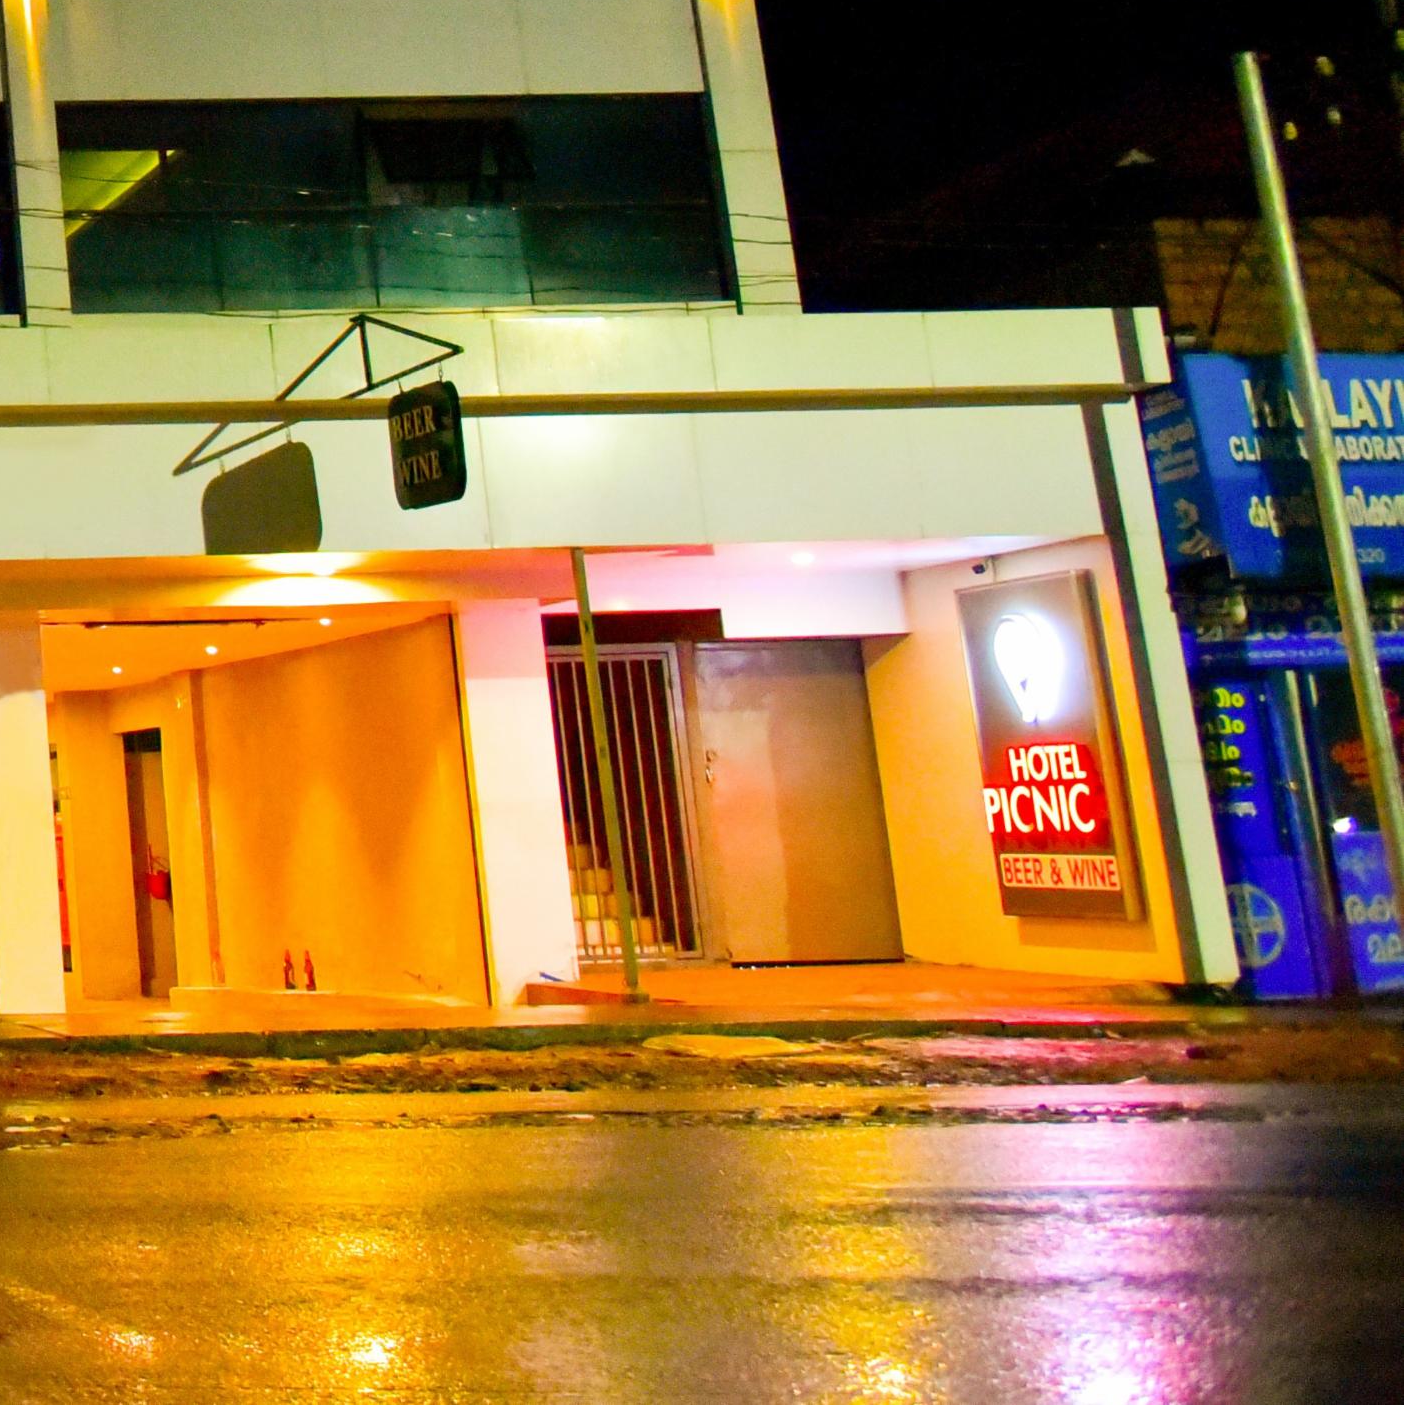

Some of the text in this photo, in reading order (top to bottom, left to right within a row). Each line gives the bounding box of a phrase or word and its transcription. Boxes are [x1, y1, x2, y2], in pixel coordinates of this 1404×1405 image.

[392, 405, 436, 440] BEER
[399, 450, 442, 485] WINE
[1008, 744, 1087, 782] HOTEL
[982, 783, 1096, 833] PICNIC
[1003, 857, 1118, 887] BEER & WINE
